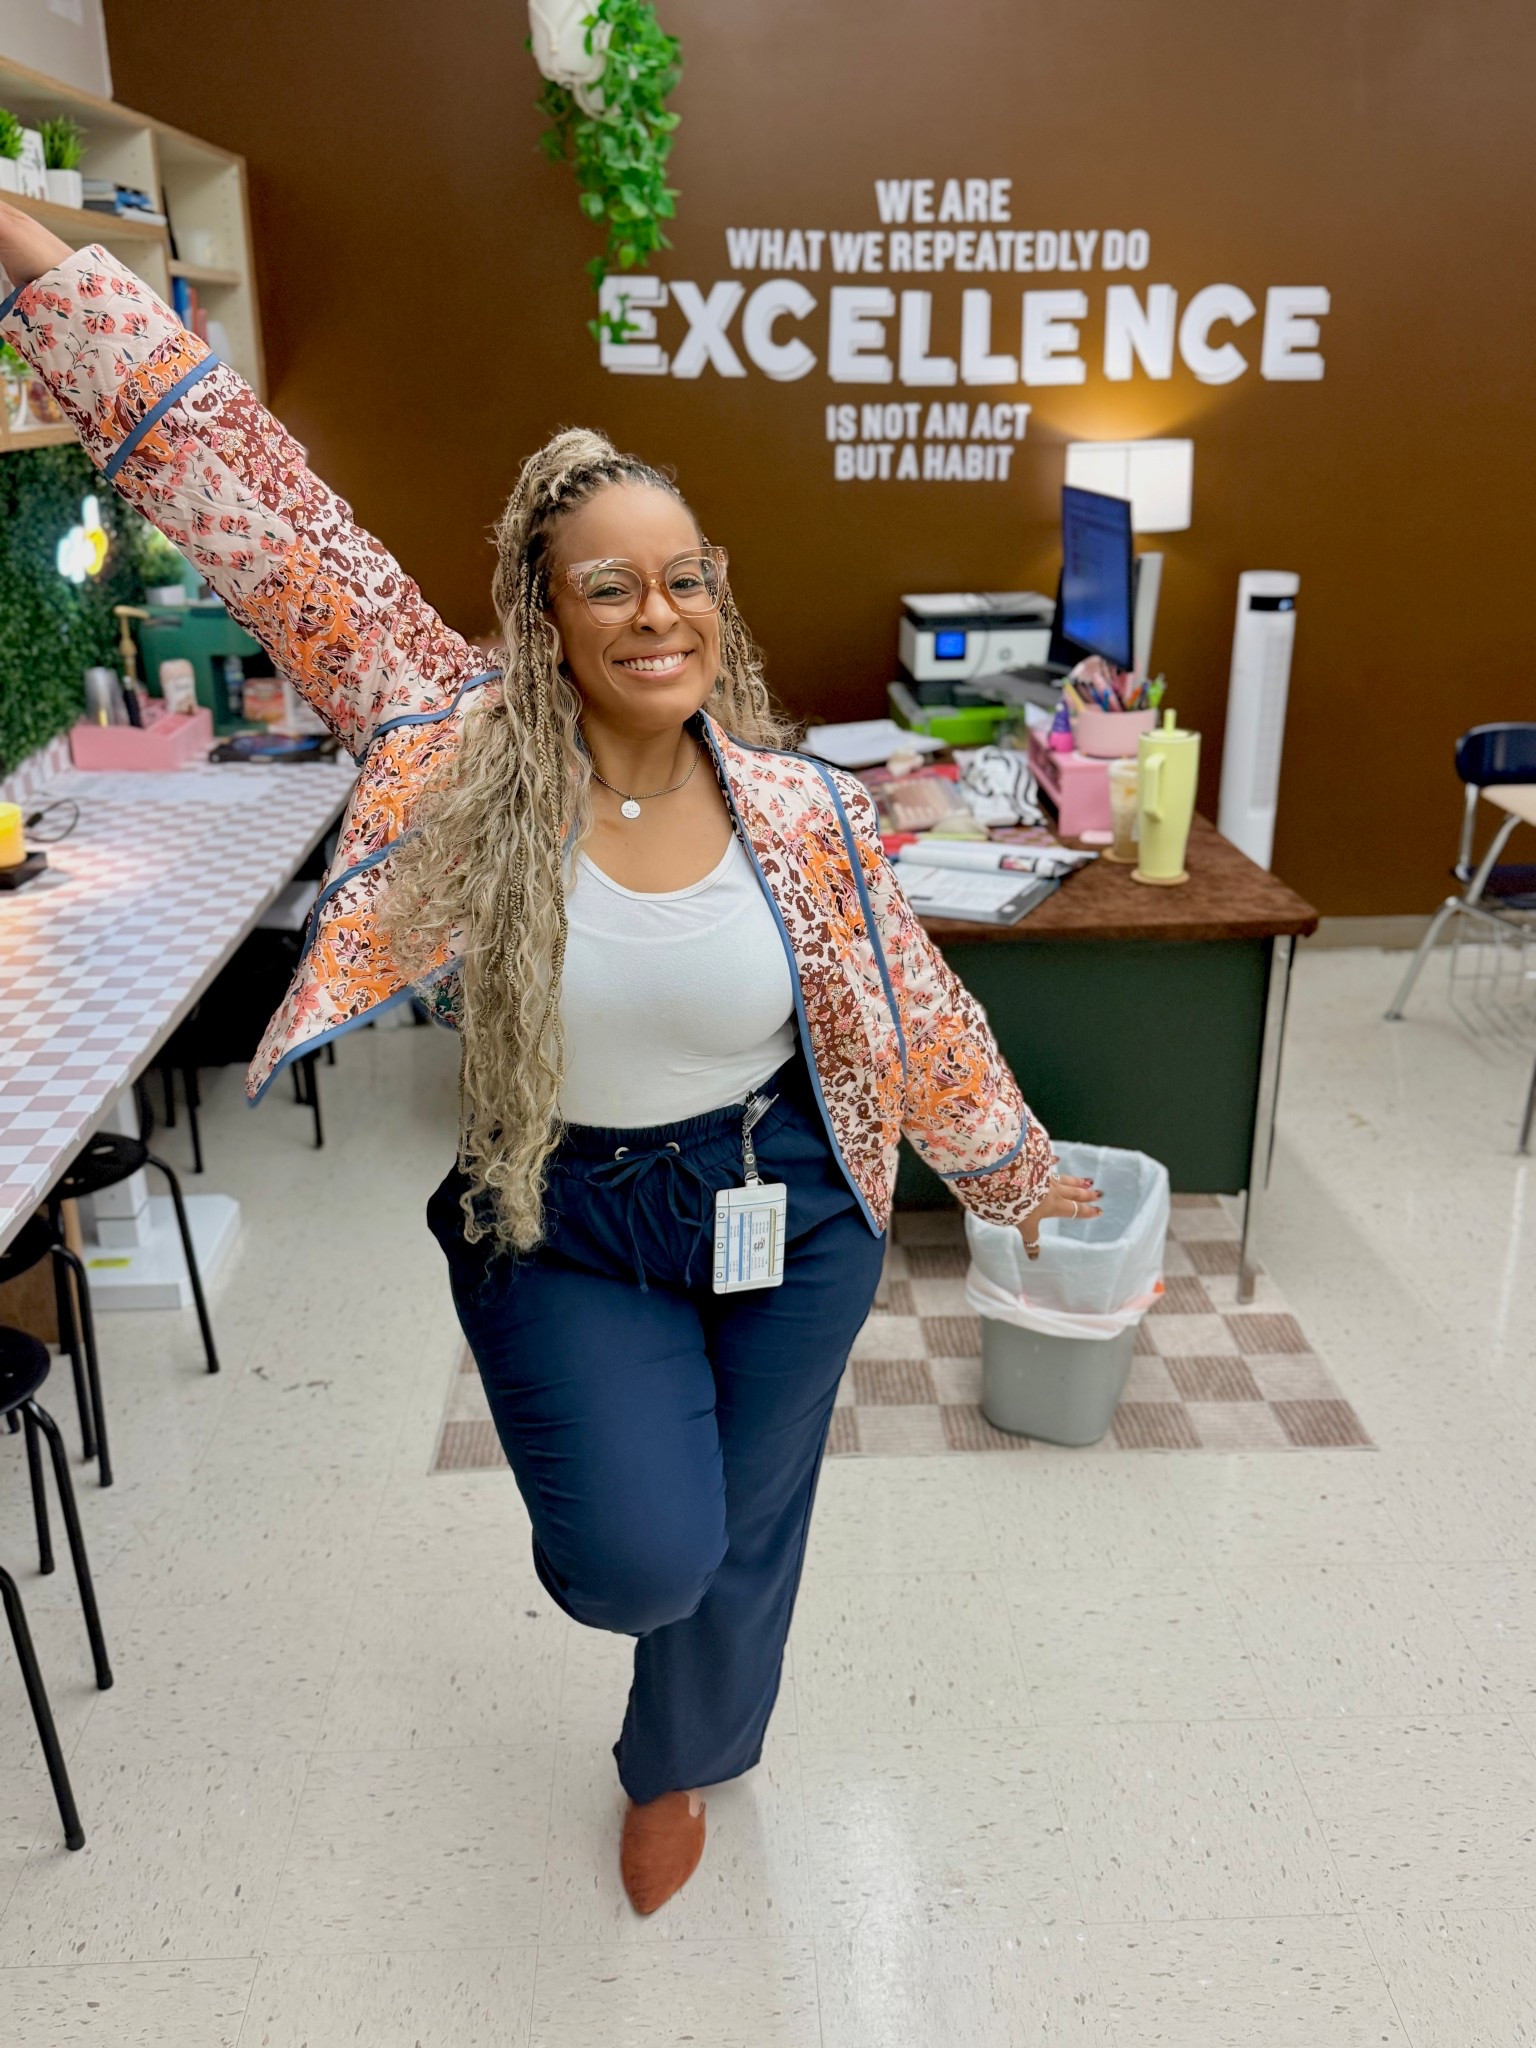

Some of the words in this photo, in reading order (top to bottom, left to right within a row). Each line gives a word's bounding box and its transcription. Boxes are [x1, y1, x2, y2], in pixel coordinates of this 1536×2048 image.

[875, 179, 935, 223] WE
[938, 178, 1012, 222] ARE
[725, 229, 825, 271] WHAT
[829, 231, 884, 273] WE
[889, 230, 1099, 272] REPEATEDLY
[1101, 229, 1150, 271] DO
[600, 276, 1330, 387] EXCELLENCE
[826, 405, 856, 441] IS
[861, 403, 921, 440] NOT
[924, 403, 967, 440] AN
[970, 402, 1032, 440] ACT
[835, 445, 894, 481] BUT
[897, 445, 918, 481] A
[923, 445, 1014, 481] HABIT
